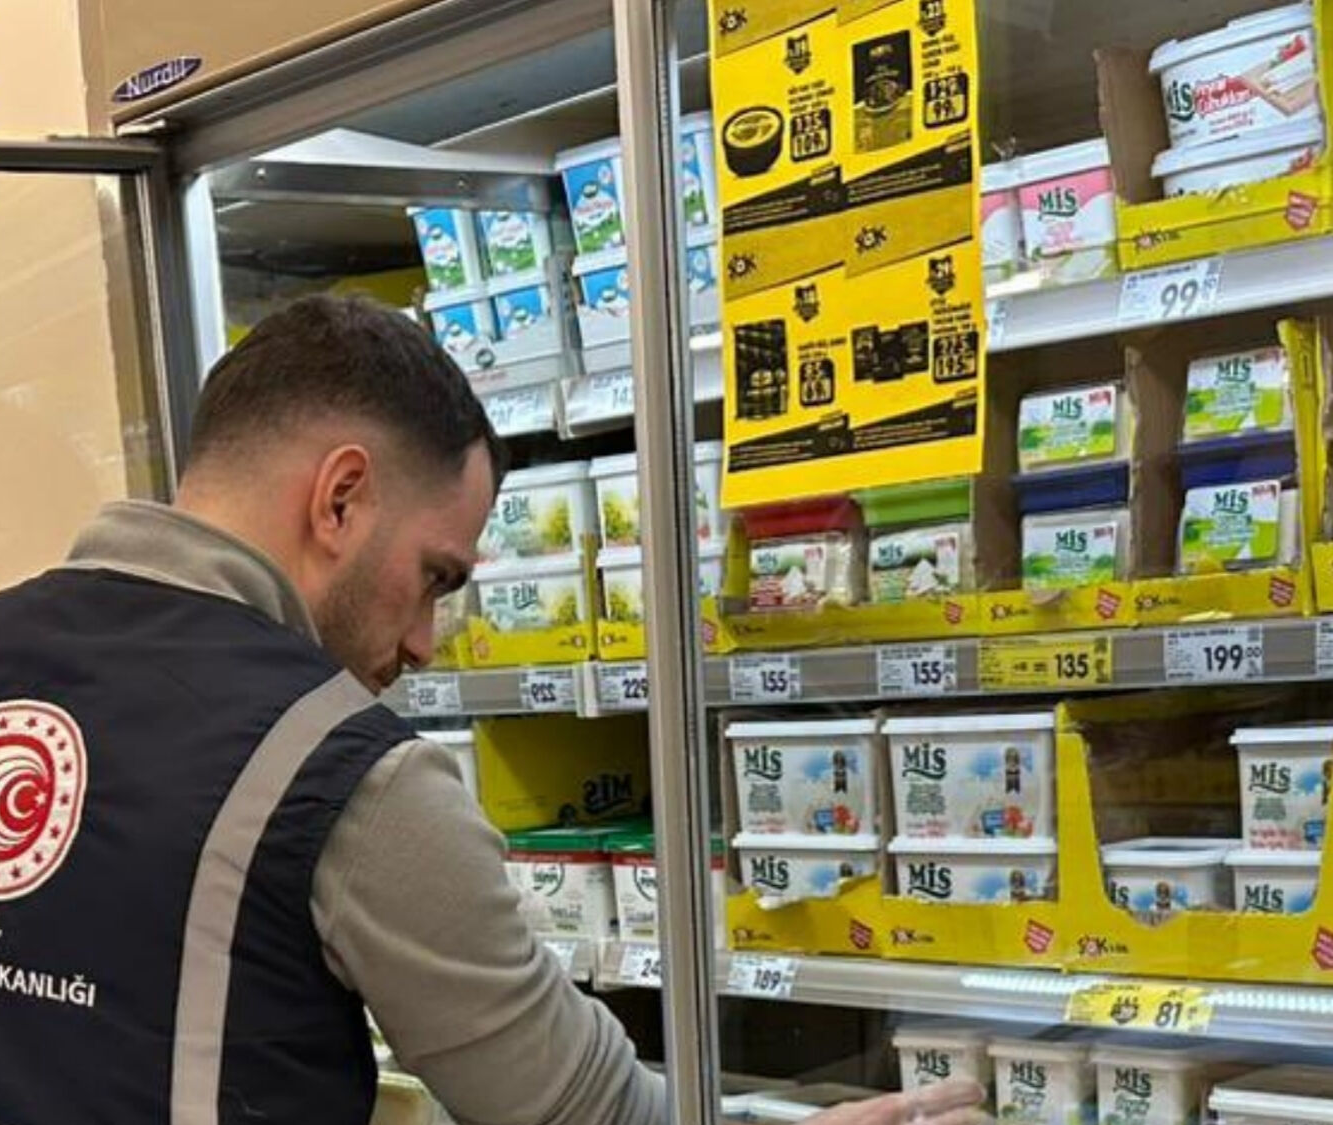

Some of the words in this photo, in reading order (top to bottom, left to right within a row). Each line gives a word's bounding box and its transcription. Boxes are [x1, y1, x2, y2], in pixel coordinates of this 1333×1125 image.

[1160, 280, 1200, 316] 99
[1054, 654, 1088, 678] 135
[1204, 646, 1243, 672] 199
[761, 671, 789, 692] 155
[912, 662, 942, 685] 155
[754, 969, 781, 989] 189
[1156, 1002, 1182, 1027] 81
